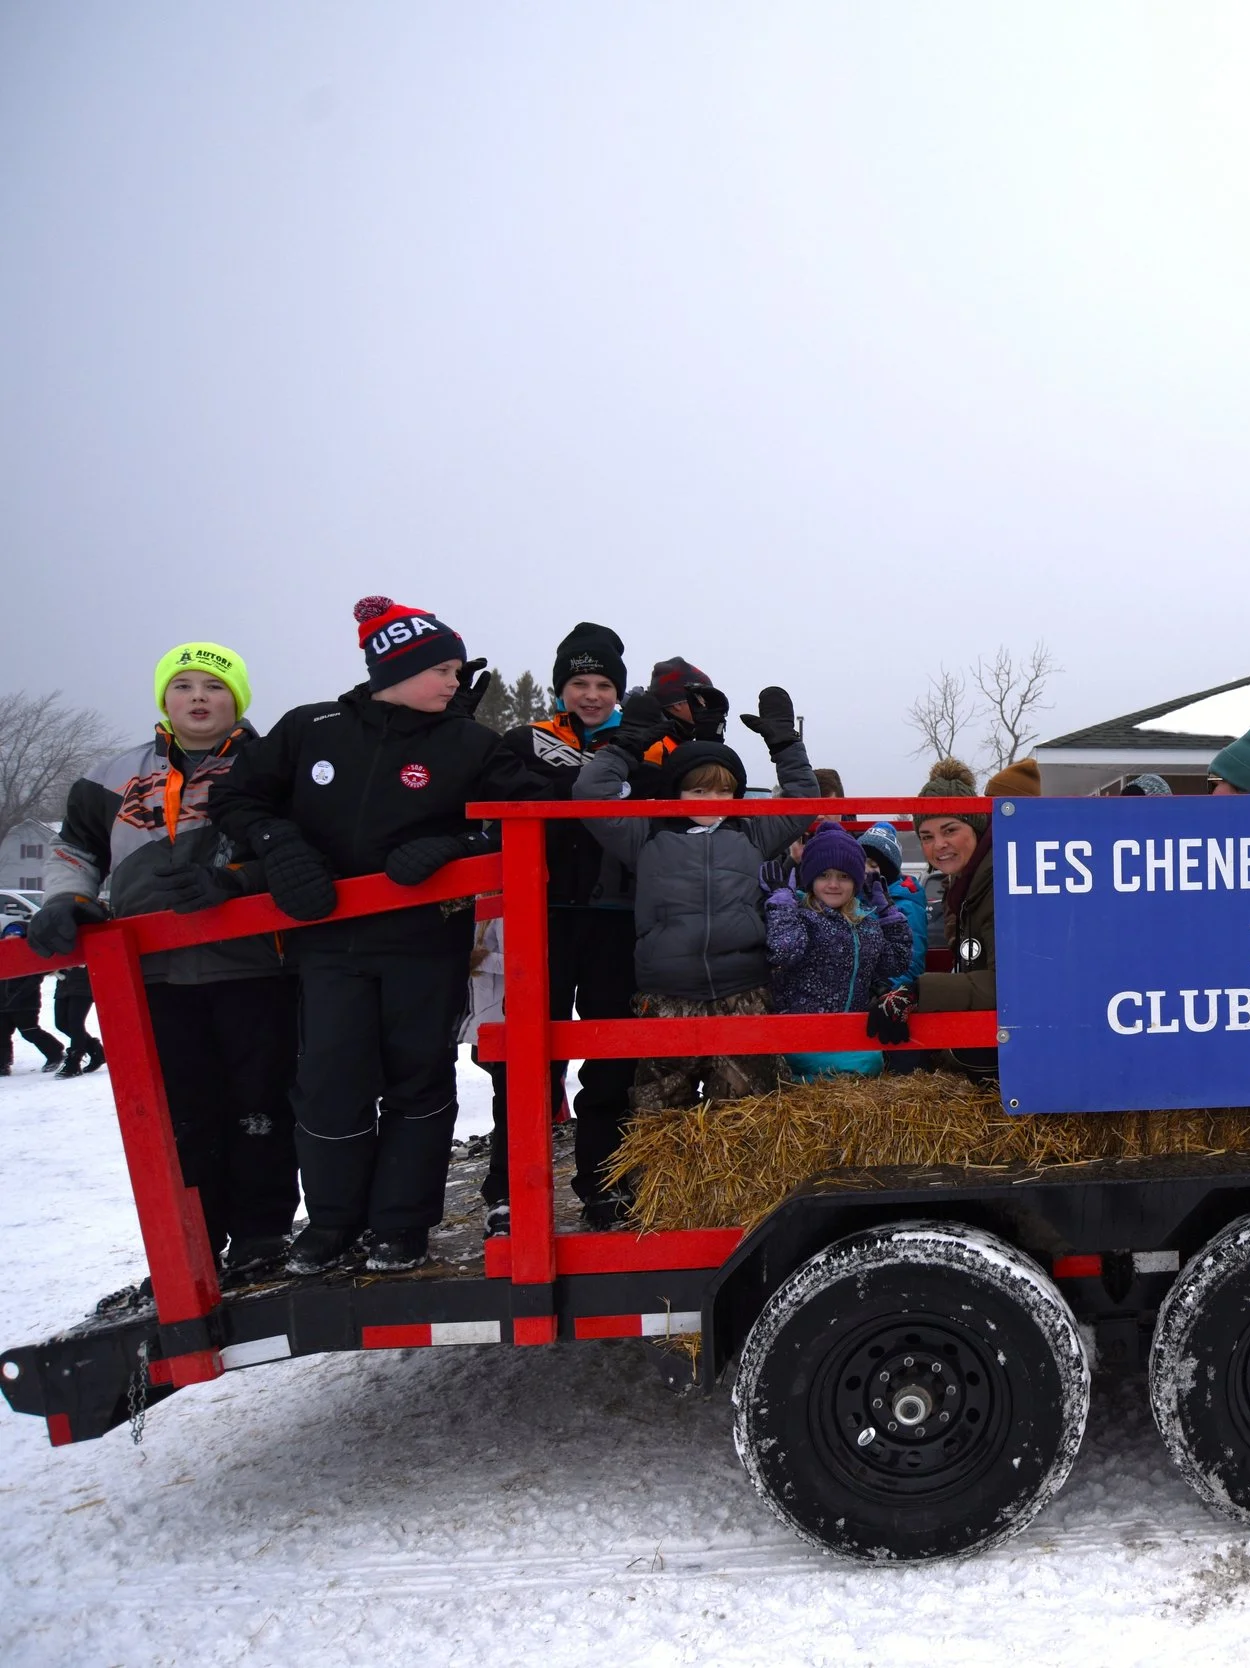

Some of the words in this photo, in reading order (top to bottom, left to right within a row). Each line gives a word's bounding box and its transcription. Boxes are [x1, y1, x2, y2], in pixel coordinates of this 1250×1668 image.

[373, 617, 438, 655] USA
[196, 650, 233, 668] AUTORE
[1007, 840, 1093, 895] LES
